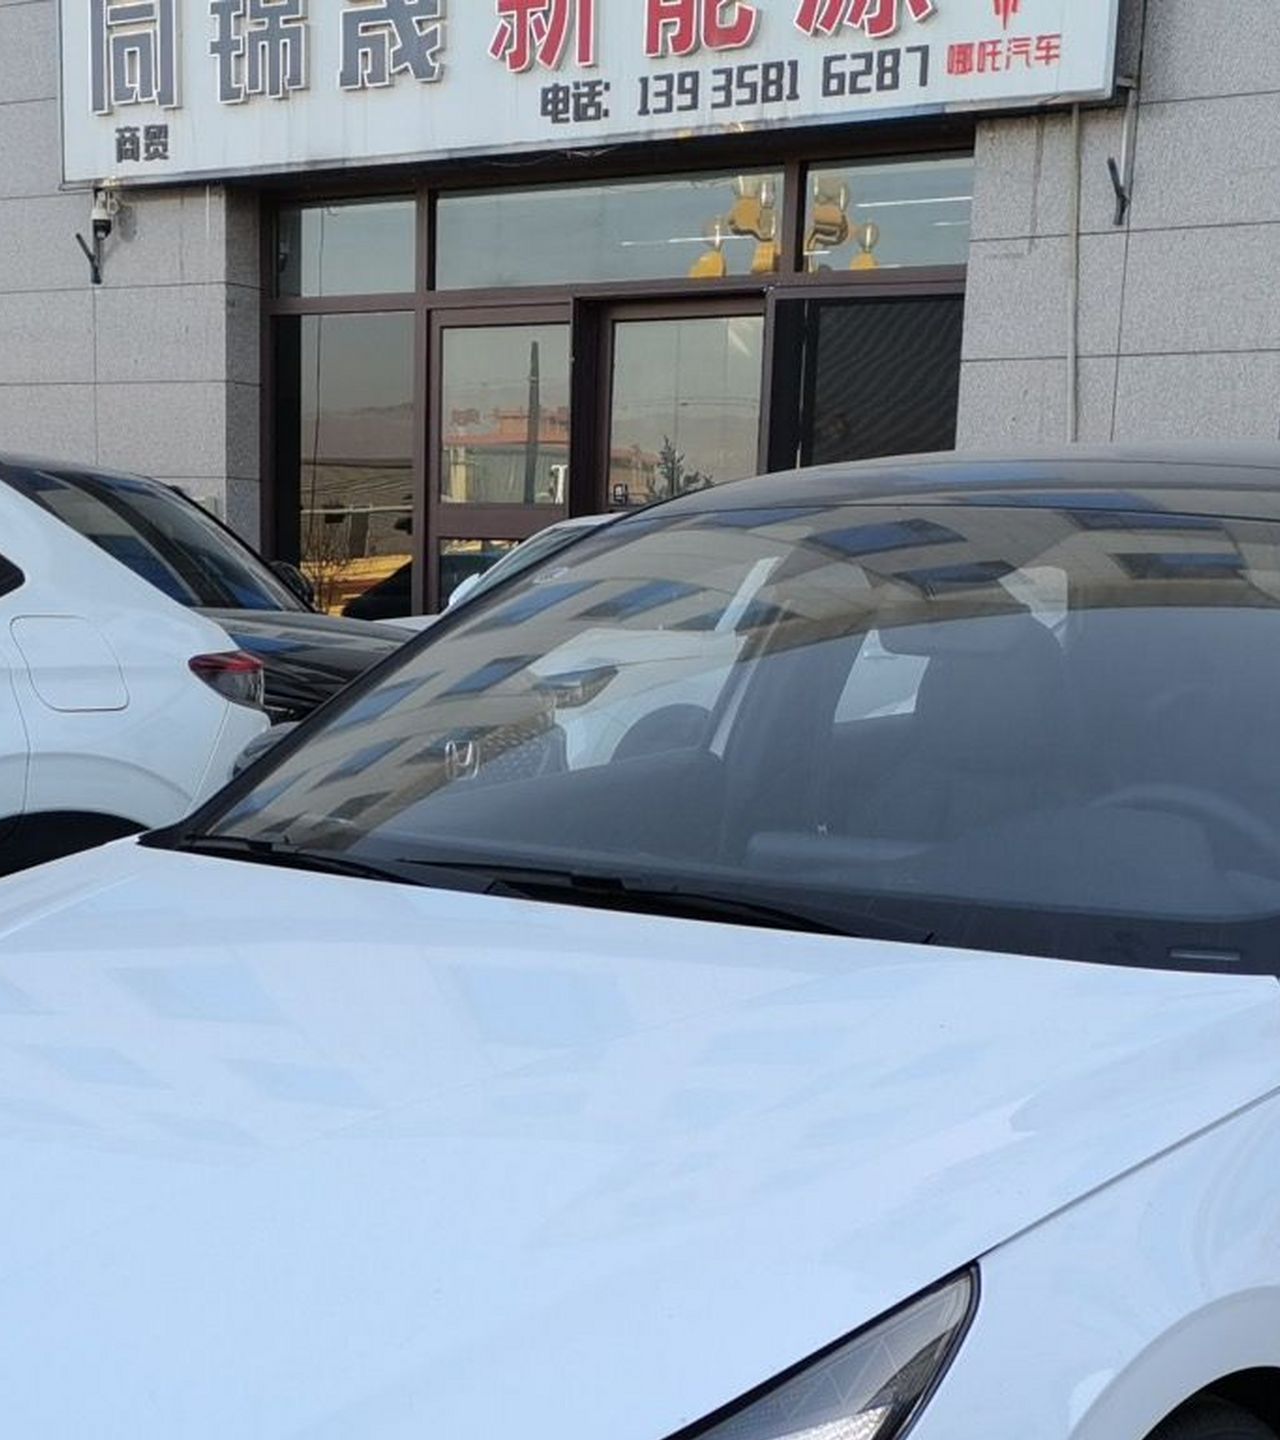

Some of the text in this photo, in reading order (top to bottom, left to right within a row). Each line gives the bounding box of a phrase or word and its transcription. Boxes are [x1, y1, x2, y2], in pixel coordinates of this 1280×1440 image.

[946, 33, 1062, 75] 哪吒汽车
[637, 70, 700, 116] 139
[711, 59, 800, 109] 3581
[821, 44, 930, 98] 6287
[115, 124, 169, 163] 商贸
